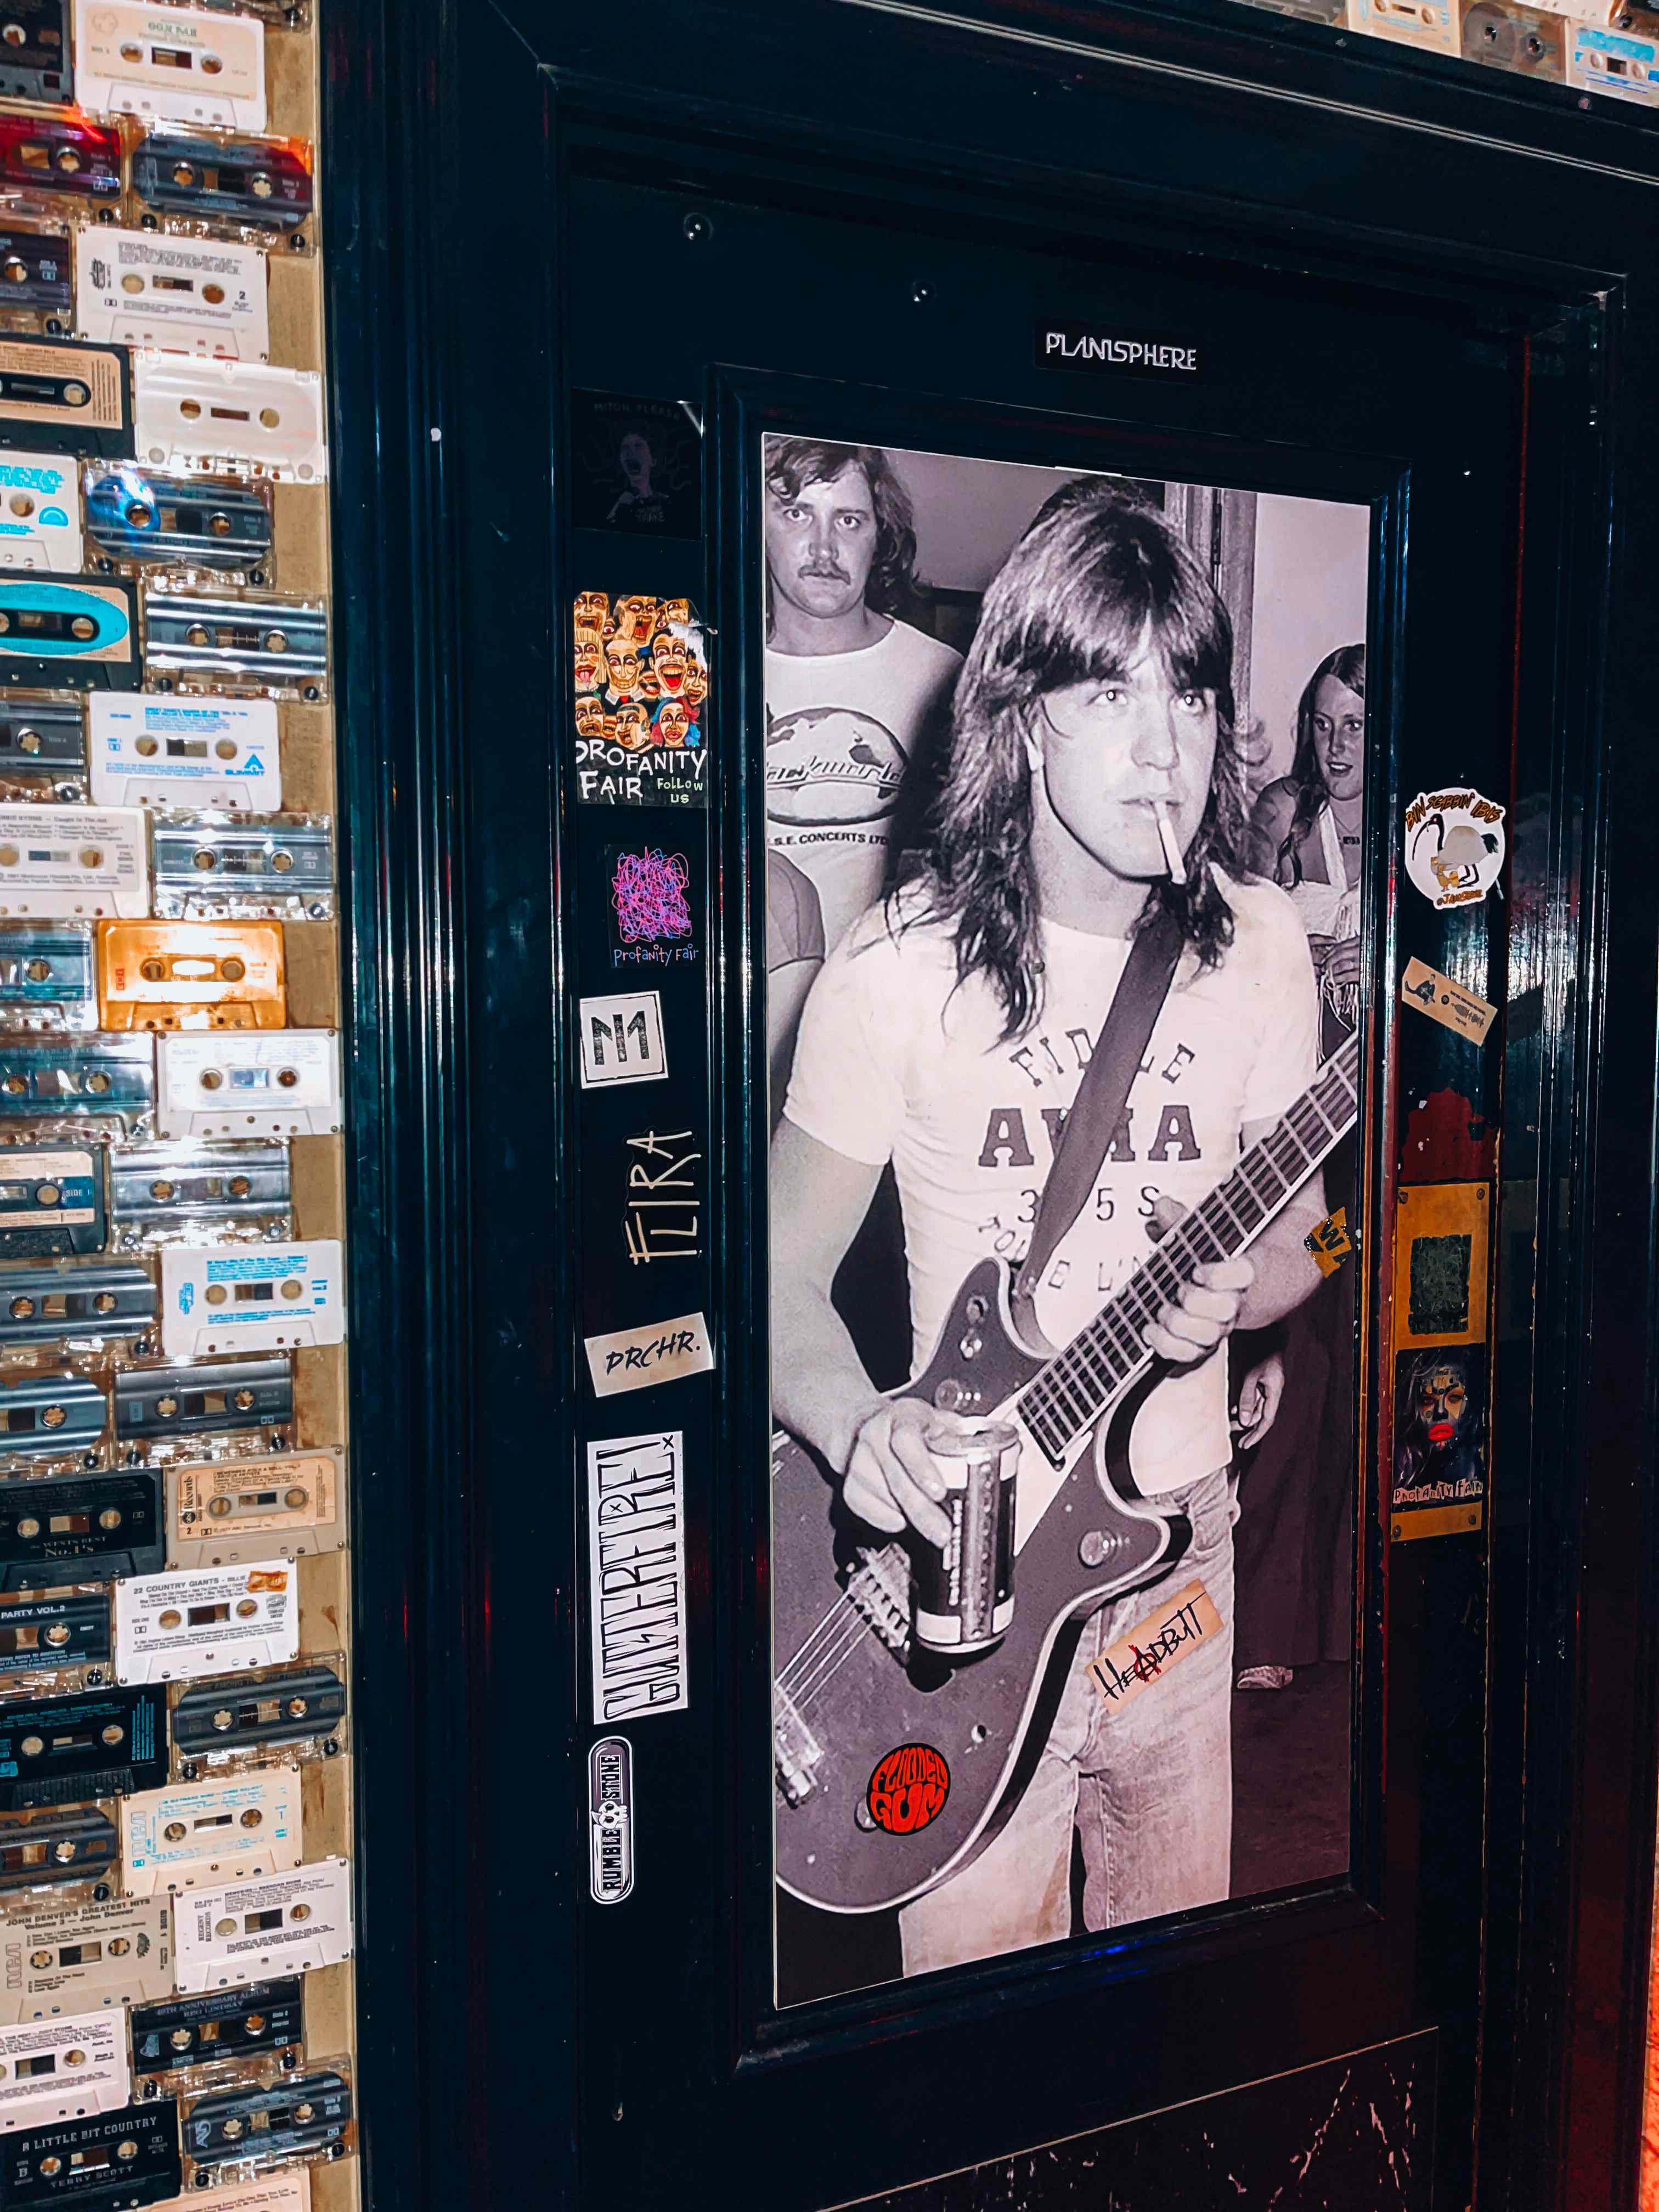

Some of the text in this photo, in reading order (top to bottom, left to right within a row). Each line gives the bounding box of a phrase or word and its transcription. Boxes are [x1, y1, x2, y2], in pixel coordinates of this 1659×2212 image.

[1046, 332, 1197, 370] PLANISPHERE
[579, 770, 643, 804] FAIR
[1406, 796, 1426, 832] BIN
[1470, 799, 1503, 823] IBIS
[799, 832, 866, 845] CONCERTS
[607, 1330, 701, 1375] PRCHR.
[146, 1582, 185, 1592] COUNTRY
[189, 1578, 218, 1587] GIANTS
[1, 1605, 65, 1618] PARTY VOL.2
[872, 1747, 949, 1792] FLOODED
[601, 1755, 623, 1893] RUMBLE STONE
[870, 1783, 945, 1832] GUM
[7, 1917, 32, 1927] JOHN
[35, 1910, 78, 1922] DENVER'S
[82, 1903, 126, 1914] GREATEST
[24, 1921, 57, 1930] Volume
[104, 1909, 134, 1918] Denver
[240, 1988, 270, 1999] ALBUM
[22, 2116, 157, 2152] A LITTLE BIT COUNTRY
[19, 2168, 27, 2177] B
